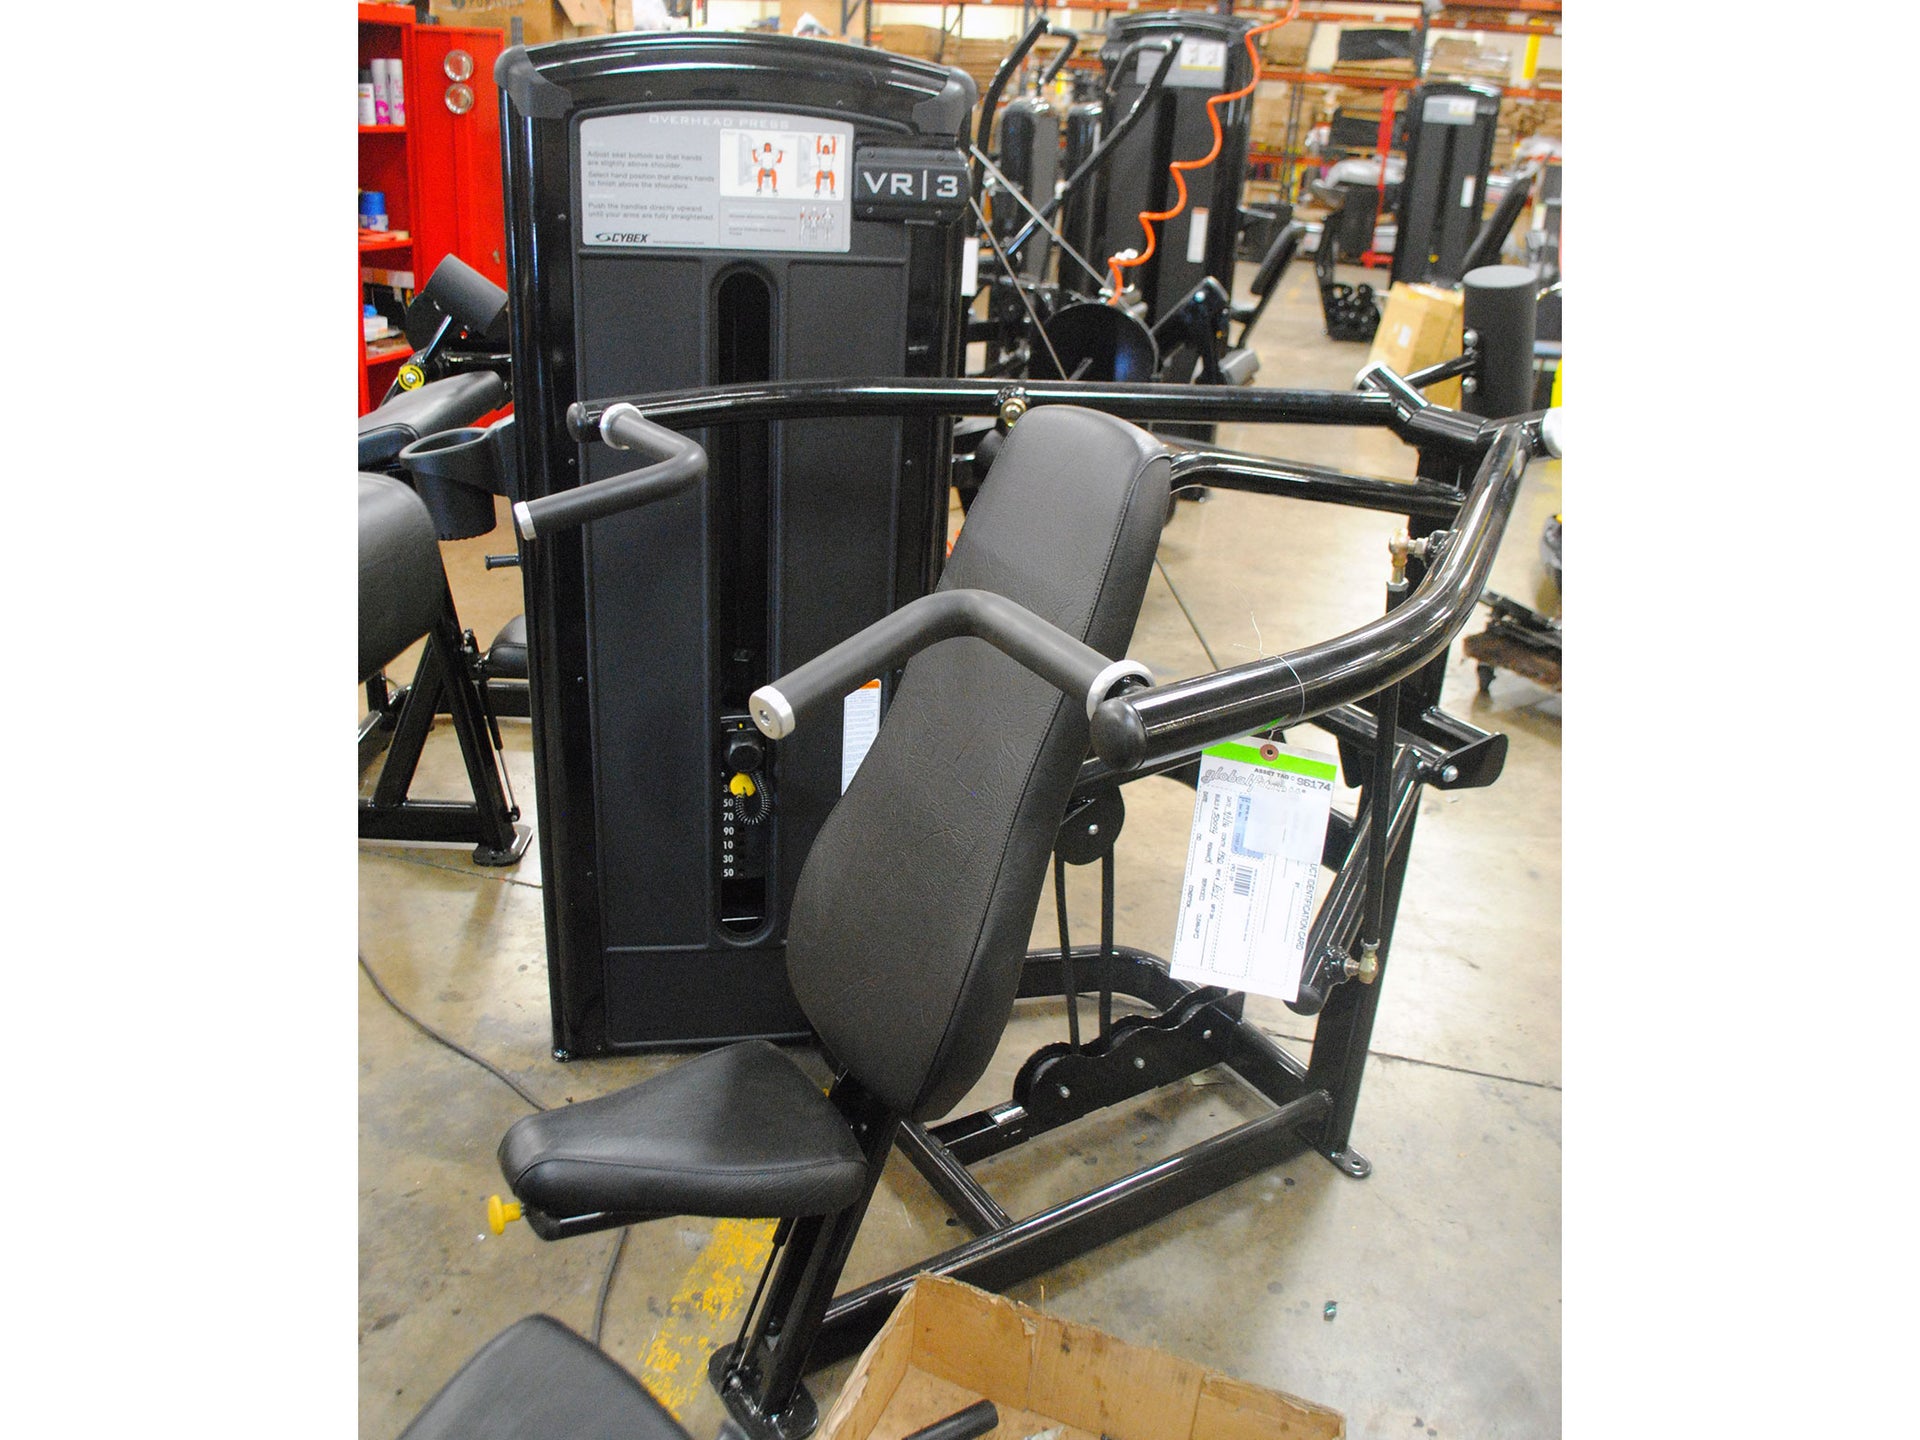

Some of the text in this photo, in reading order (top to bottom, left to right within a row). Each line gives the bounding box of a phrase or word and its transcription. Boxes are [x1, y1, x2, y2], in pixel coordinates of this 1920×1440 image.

[648, 115, 790, 129] OVERHEAD PRESS
[601, 160, 625, 168] slightly
[629, 173, 656, 181] position
[650, 204, 675, 212] directly
[654, 212, 669, 220] fully
[611, 232, 649, 243] CYBEX
[1296, 776, 1332, 791] 96174
[723, 797, 734, 808] 50
[723, 812, 734, 821] 70
[723, 826, 735, 836] 90
[723, 854, 734, 864] 30
[723, 868, 735, 878] 50
[1295, 931, 1306, 950] CARD
